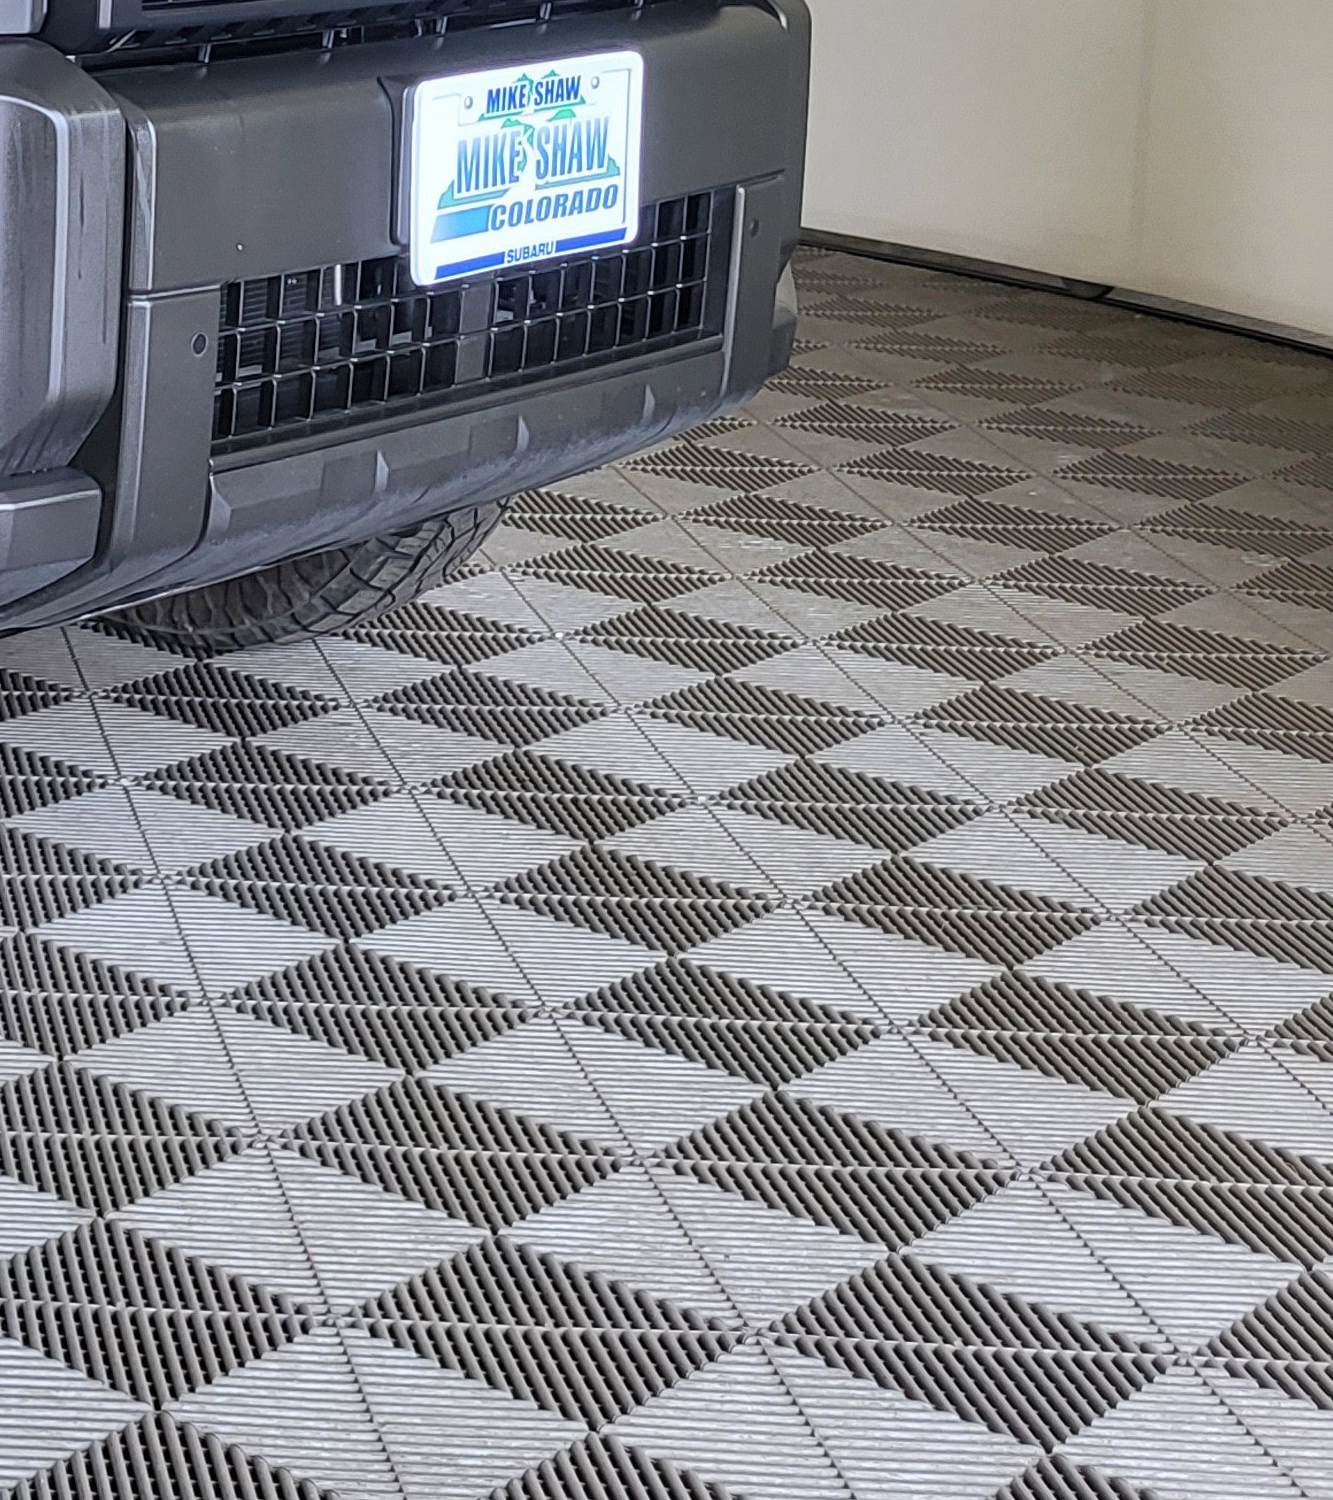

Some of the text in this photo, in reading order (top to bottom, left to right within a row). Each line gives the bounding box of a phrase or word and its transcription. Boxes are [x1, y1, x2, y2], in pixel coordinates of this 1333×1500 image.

[486, 76, 581, 114] MIKE SHAW
[456, 116, 609, 194] MIKE SHAW
[489, 184, 619, 231] COLORADO
[506, 241, 554, 264] SUBARU
